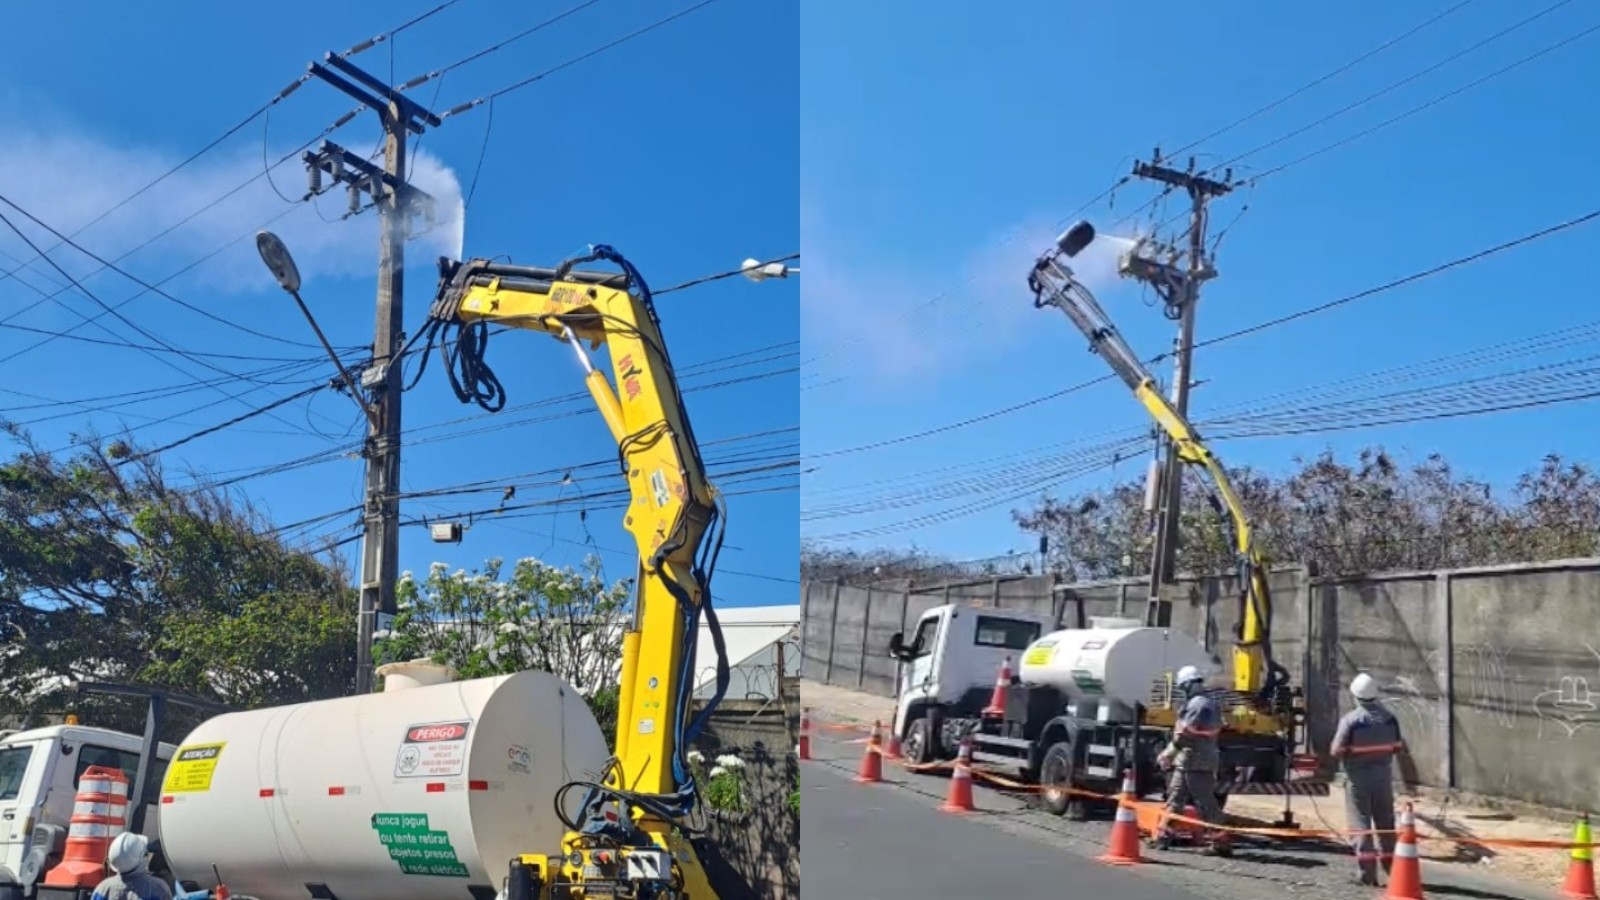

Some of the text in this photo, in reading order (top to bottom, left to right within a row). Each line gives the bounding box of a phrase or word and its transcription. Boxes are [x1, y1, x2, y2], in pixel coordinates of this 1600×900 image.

[416, 726, 455, 739] PERIGO
[182, 748, 216, 760] ATENÇÃO
[401, 815, 426, 829] jogue
[381, 832, 447, 845] ou tente retirar
[391, 847, 455, 860] objetos presos
